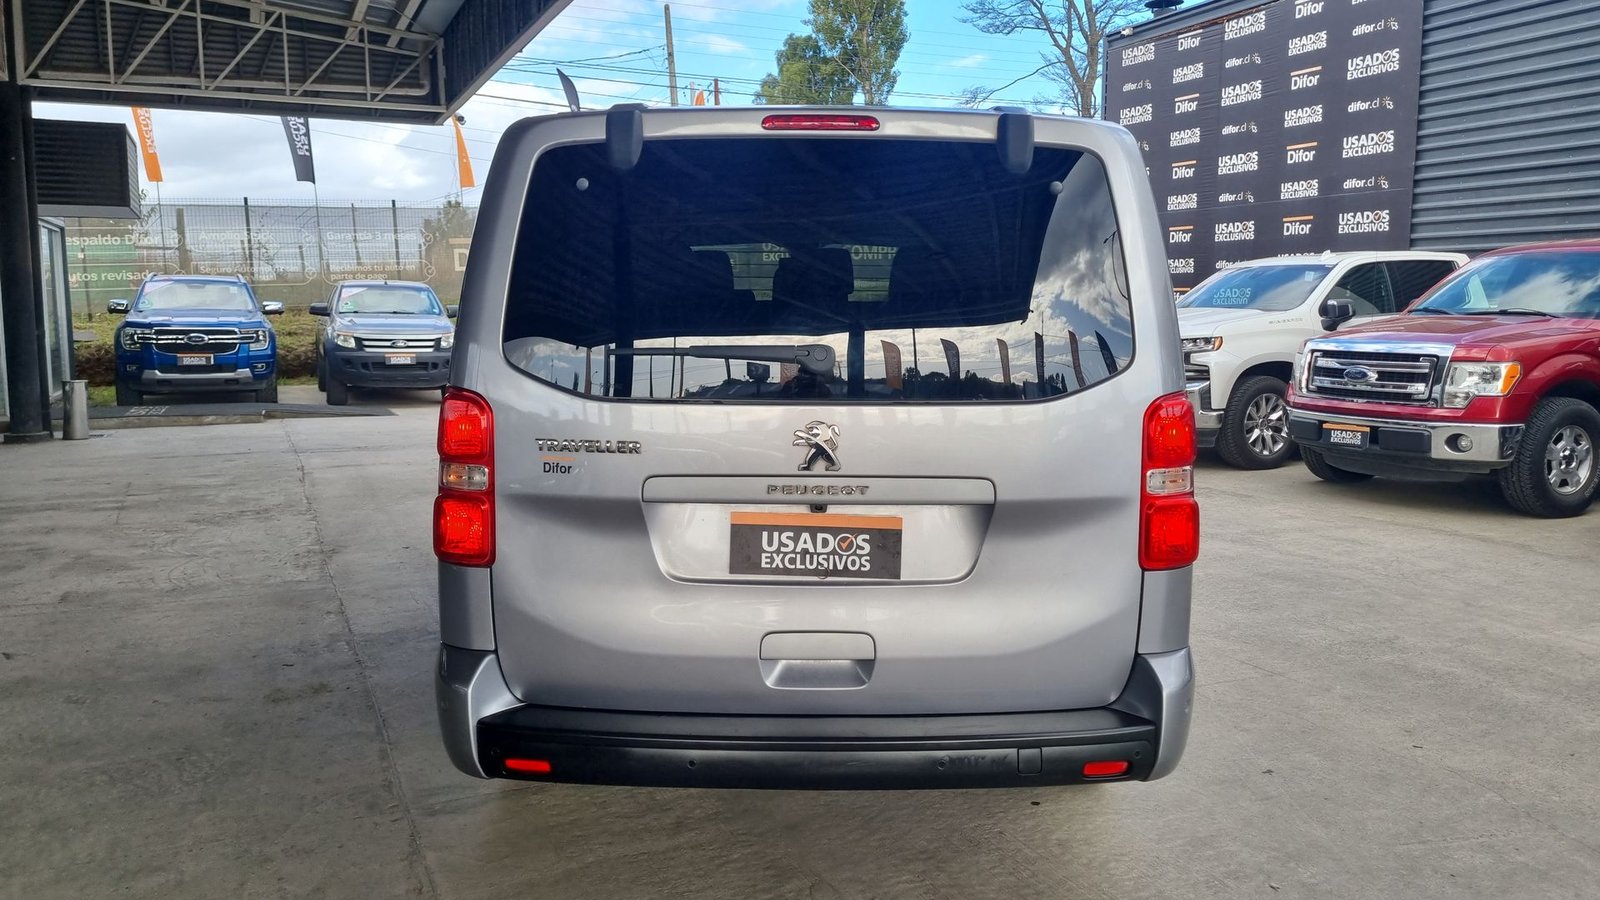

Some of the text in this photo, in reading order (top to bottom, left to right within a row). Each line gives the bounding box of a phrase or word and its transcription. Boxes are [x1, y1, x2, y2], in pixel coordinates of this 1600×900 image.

[1295, 2, 1324, 19] Difor
[1226, 11, 1265, 32] USADOS
[1353, 19, 1384, 36] difor.cl
[1225, 23, 1265, 40] EXCLUSIVOS
[1178, 36, 1200, 50] Difor
[1289, 31, 1327, 48] USADOS
[1122, 42, 1154, 59] USADOS
[1288, 41, 1327, 56] EXCLUSIVOS
[1122, 54, 1154, 66] EXCLUSIVOS
[1225, 54, 1250, 68] difor.cl
[1348, 48, 1400, 70] USADOS
[1173, 62, 1203, 77] USADOS
[1347, 61, 1399, 80] EXCLUSIVOS
[1172, 70, 1203, 84] EXCLUSIVOS
[1291, 73, 1319, 90] Difor
[1123, 81, 1143, 92] difor.cl
[1222, 80, 1262, 98] USADOS
[1221, 91, 1261, 106] EXCLUSIVOS
[1348, 98, 1380, 112] difor.cl
[1120, 104, 1152, 118] USADOS
[1175, 102, 1197, 114] Difor
[1285, 105, 1322, 120] USADOS
[1120, 114, 1152, 126] EXCLUSIVOS
[1284, 115, 1322, 128] EXCLUSIVOS
[1170, 128, 1200, 140] USADOS
[1222, 122, 1246, 135] difor.cl
[1170, 136, 1200, 147] EXCLUSIVOS
[1344, 130, 1394, 149] USADOS
[1287, 149, 1315, 164] Difor
[1342, 143, 1394, 158] EXCLUSIVOS
[1219, 152, 1258, 167] USADOS
[1172, 167, 1195, 179] Difor
[1218, 162, 1258, 175] EXCLUSIVOS
[1281, 180, 1318, 193] USADOS
[1344, 177, 1375, 189] difor.cl
[1168, 194, 1197, 204] USADOS
[1219, 192, 1243, 202] difor.cl
[1281, 189, 1318, 199] EXCLUSIVOS
[1168, 201, 1197, 210] EXCLUSIVOS
[1339, 210, 1390, 225] USADOS
[1216, 221, 1254, 234] USADOS
[1283, 222, 1311, 236] Difor
[1339, 222, 1389, 234] EXCLUSIVOS
[1169, 232, 1192, 243] Difor
[1215, 232, 1254, 242] EXCLUSIVOS
[843, 245, 897, 260] OMPR
[1168, 258, 1194, 268] SADOS
[355, 272, 366, 280] de
[1331, 437, 1360, 445] EXCLUSIVOS
[1332, 430, 1361, 440] USADOS
[536, 438, 642, 454] TRAVELLER
[543, 462, 572, 474] Difor
[767, 484, 869, 496] PEUGEOT
[762, 532, 870, 554] USADOS
[761, 554, 870, 571] EXCLUSIVOS
